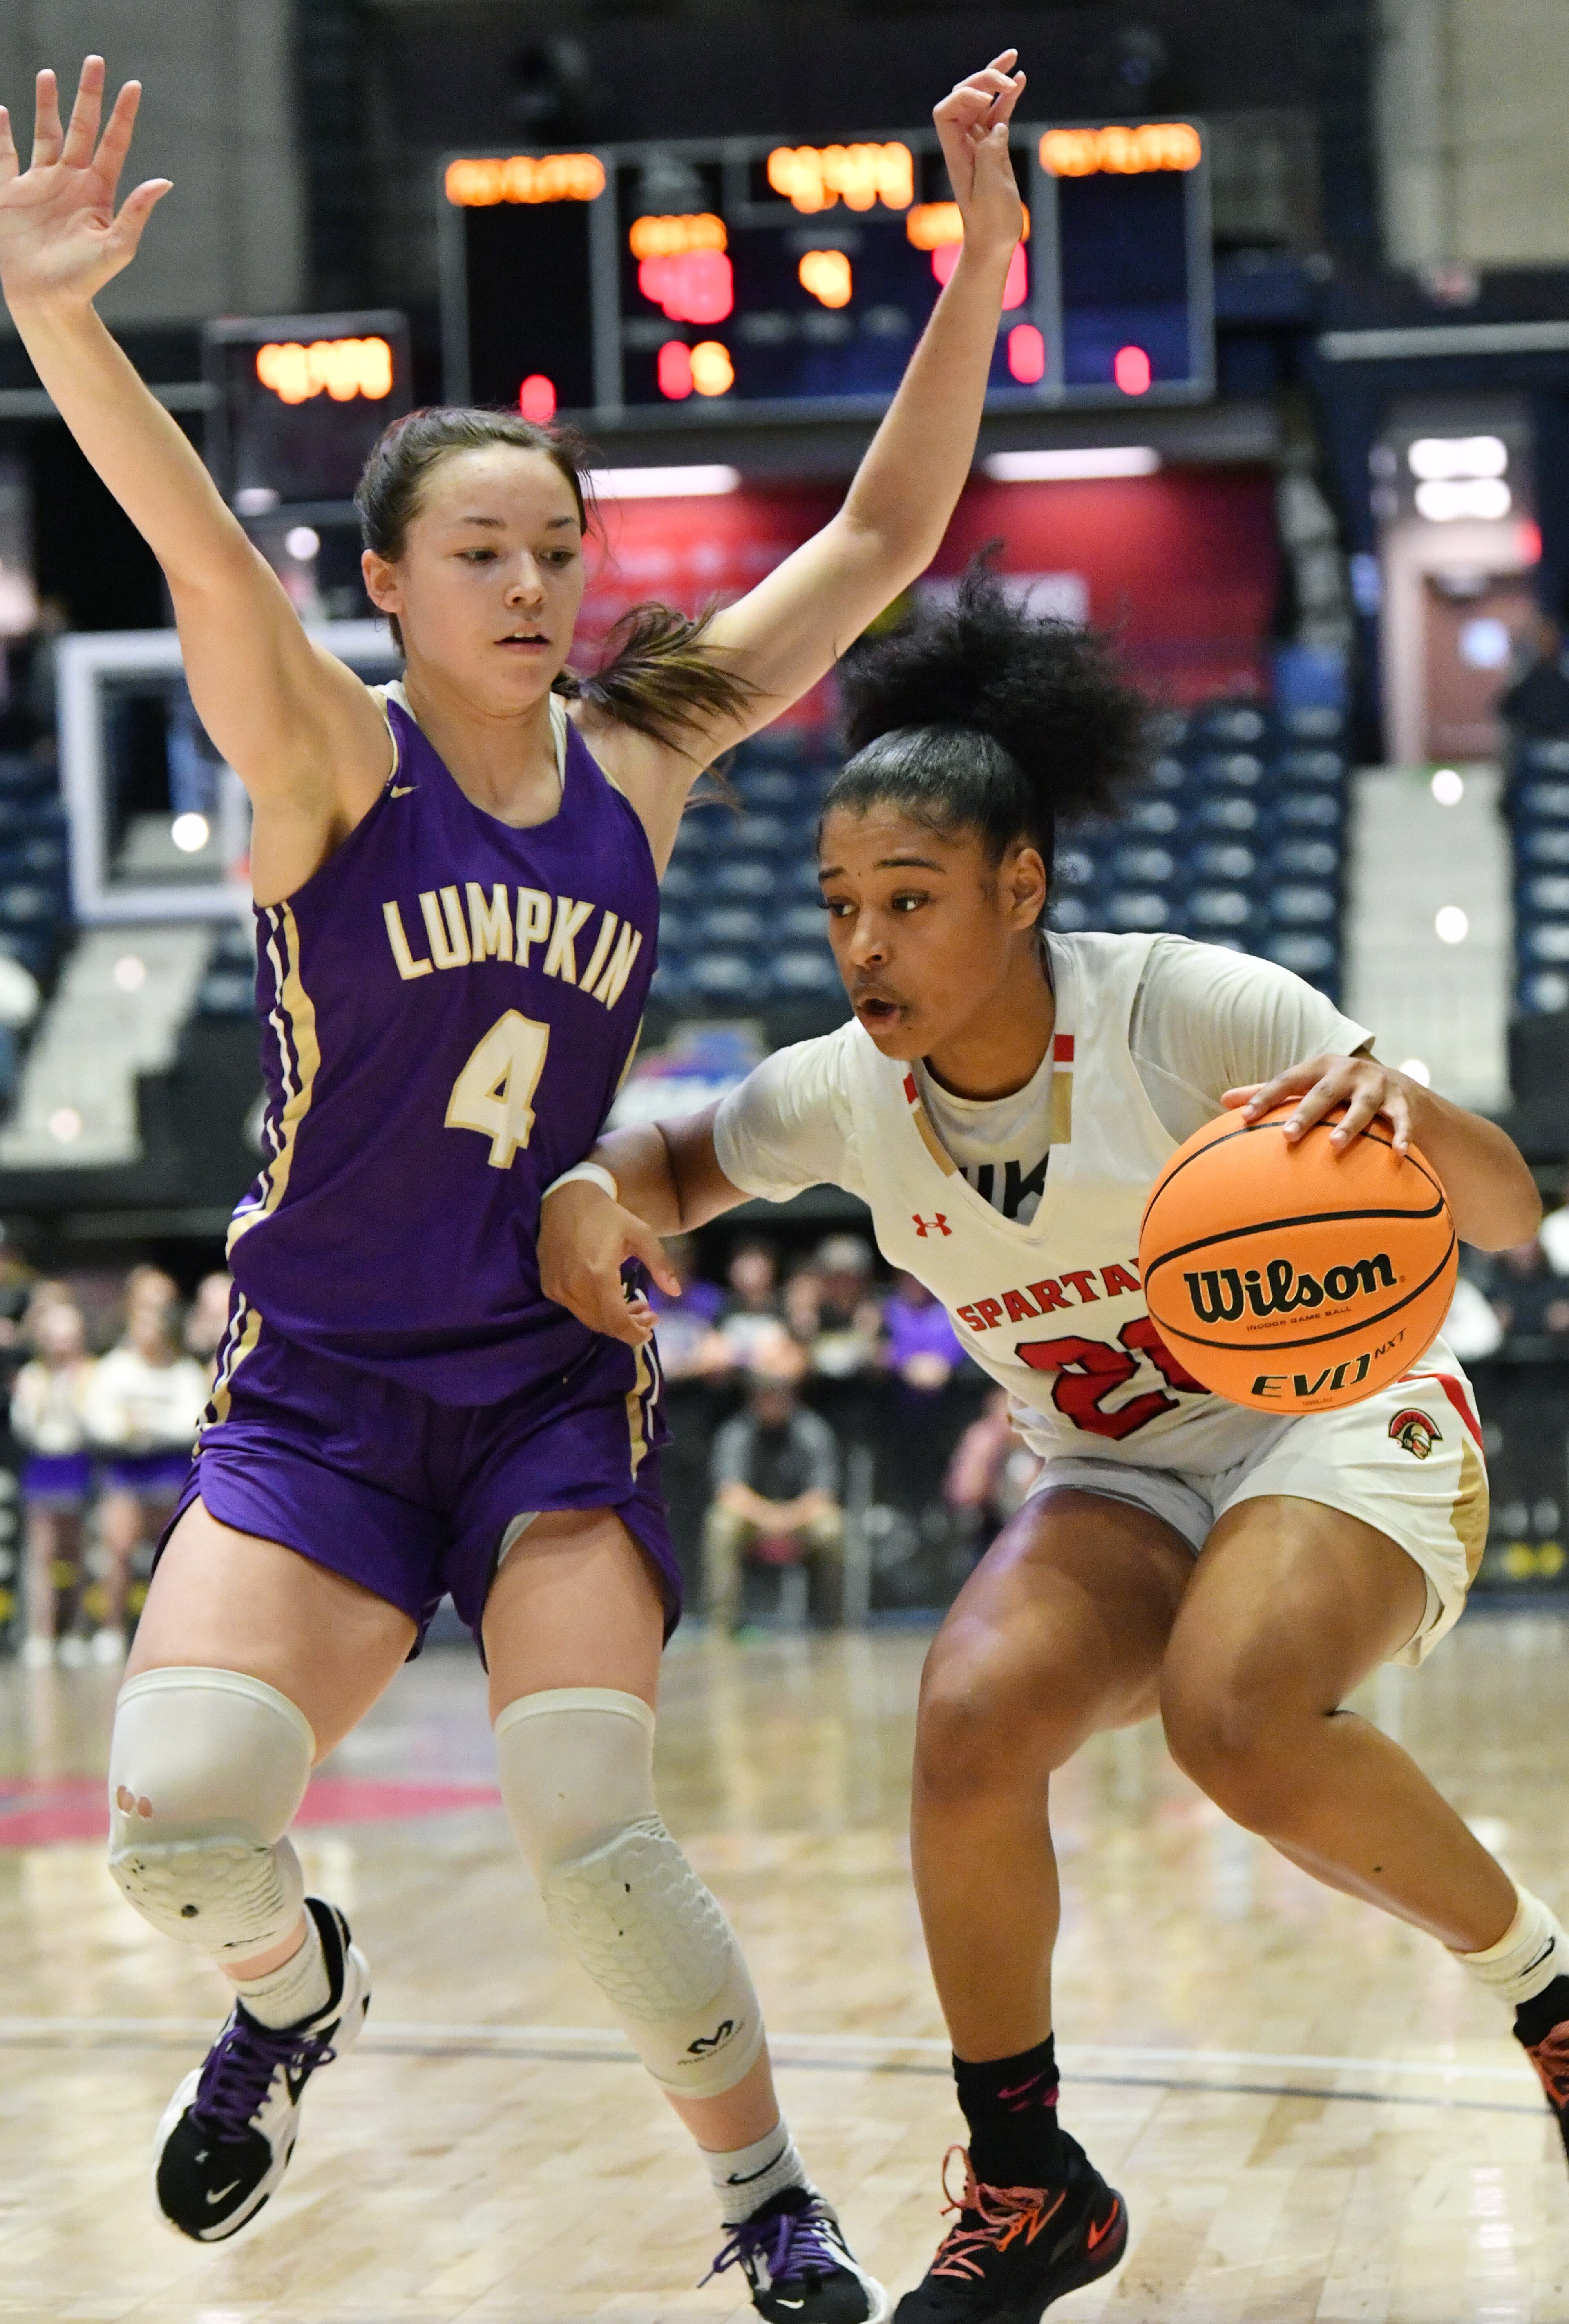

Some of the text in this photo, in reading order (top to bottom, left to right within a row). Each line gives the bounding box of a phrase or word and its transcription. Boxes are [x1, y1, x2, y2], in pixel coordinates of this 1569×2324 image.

[382, 882, 643, 1010] LUMPKIN
[444, 1008, 550, 1169] 4
[957, 1258, 1142, 1332] SPARTA
[1183, 1253, 1397, 1324] Wilson
[1246, 1306, 1352, 1332] INDOOR GAME BALL
[1250, 1327, 1407, 1398] EVO NXT
